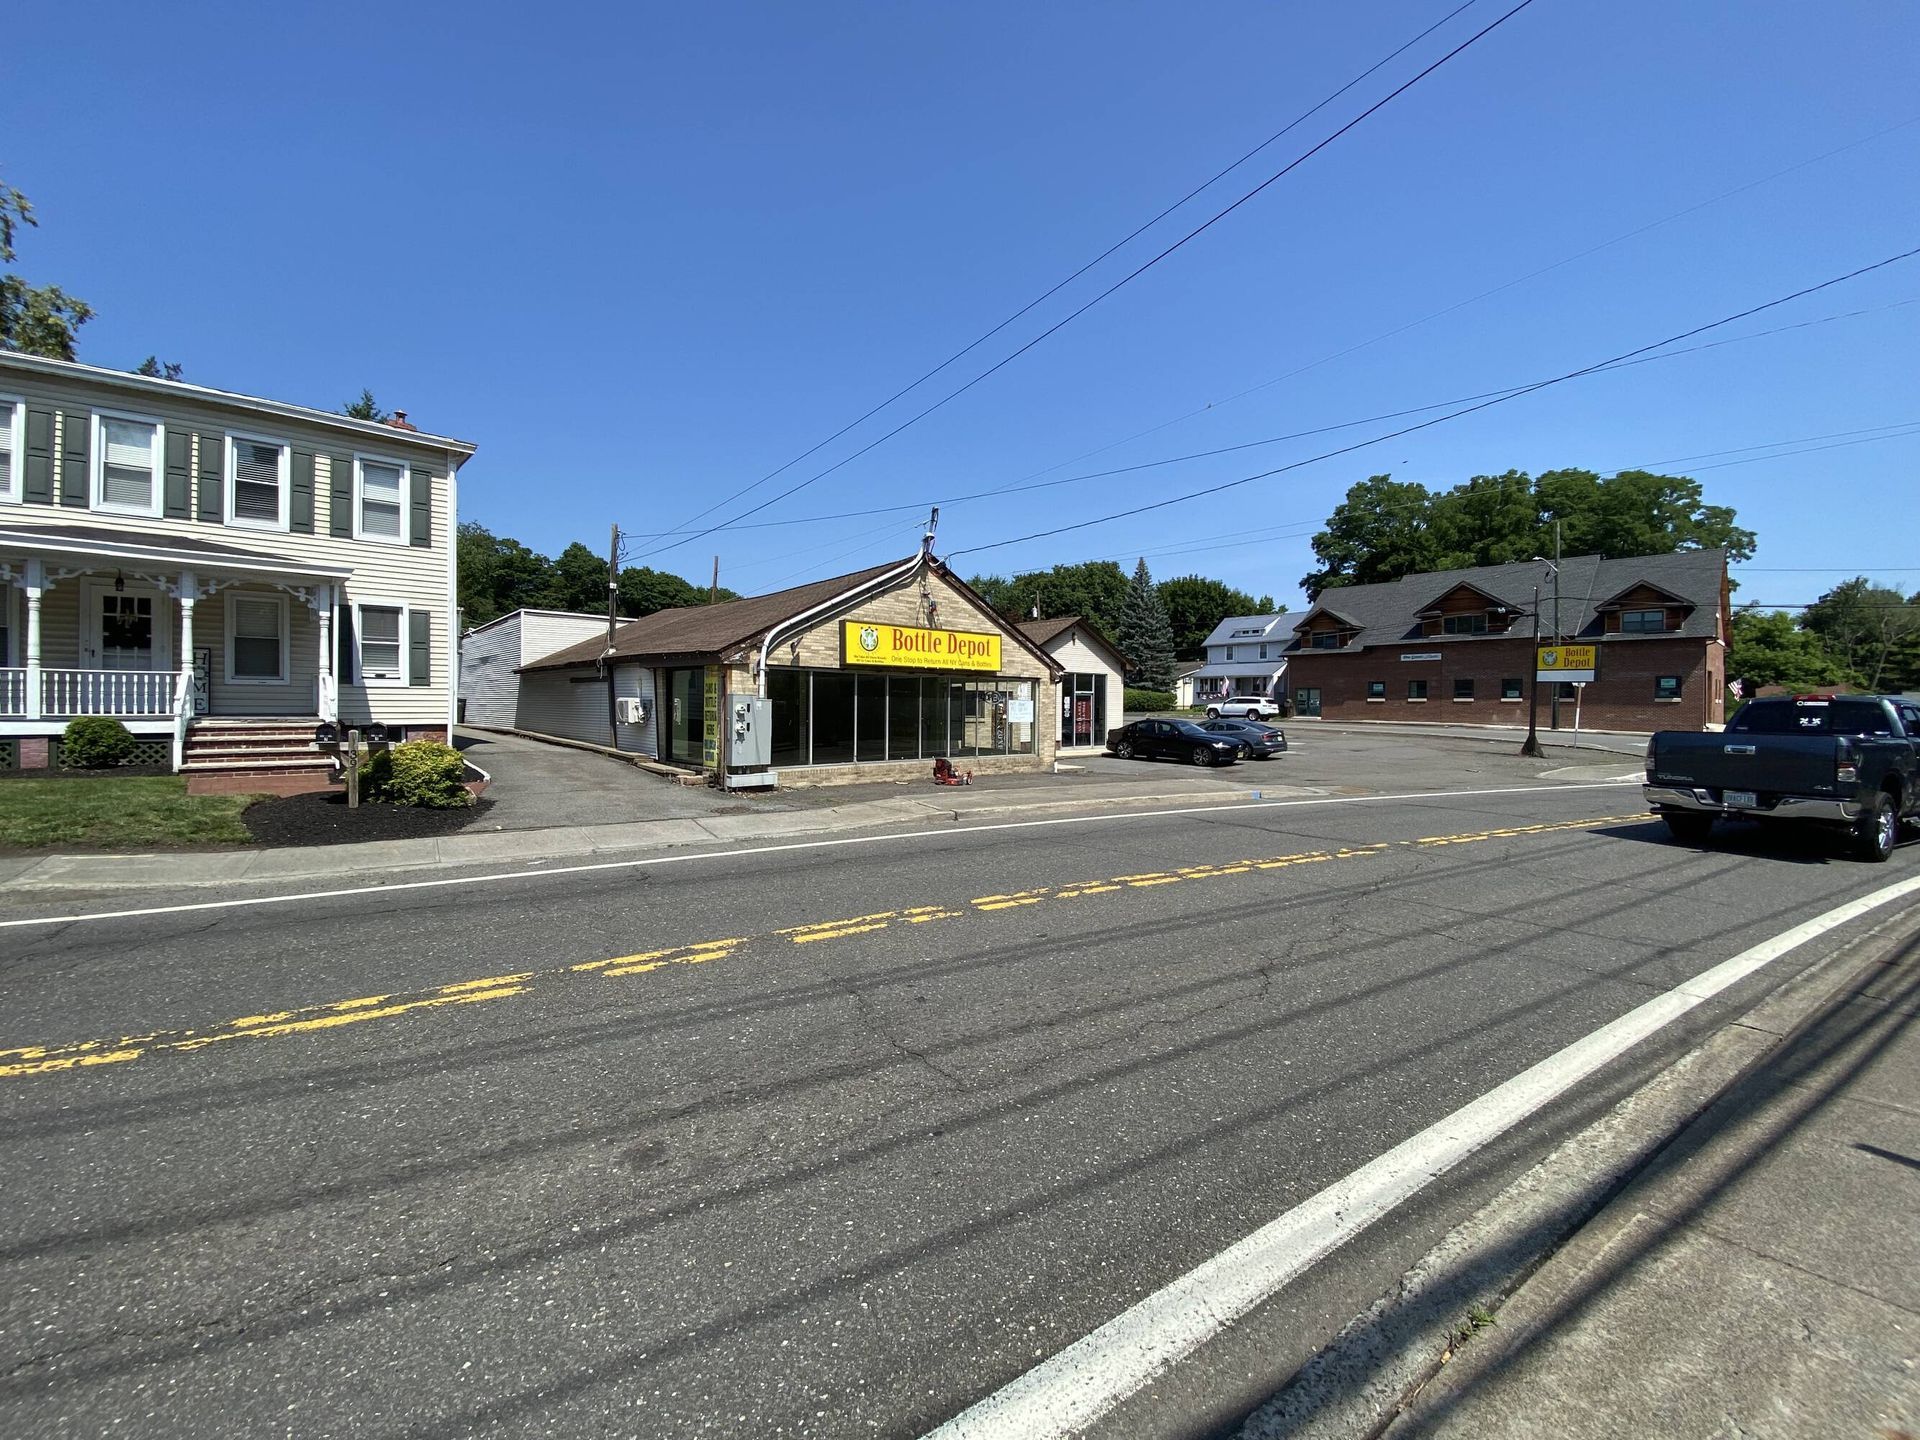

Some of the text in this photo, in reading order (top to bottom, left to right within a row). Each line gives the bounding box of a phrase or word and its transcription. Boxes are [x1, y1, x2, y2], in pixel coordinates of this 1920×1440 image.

[892, 628, 991, 659] Bottle Depot
[1565, 647, 1591, 657] Bottle
[891, 655, 902, 663] One
[903, 656, 916, 664] Stop
[924, 657, 942, 665] Return
[958, 659, 970, 667] Cans
[1563, 657, 1590, 668] Depot
